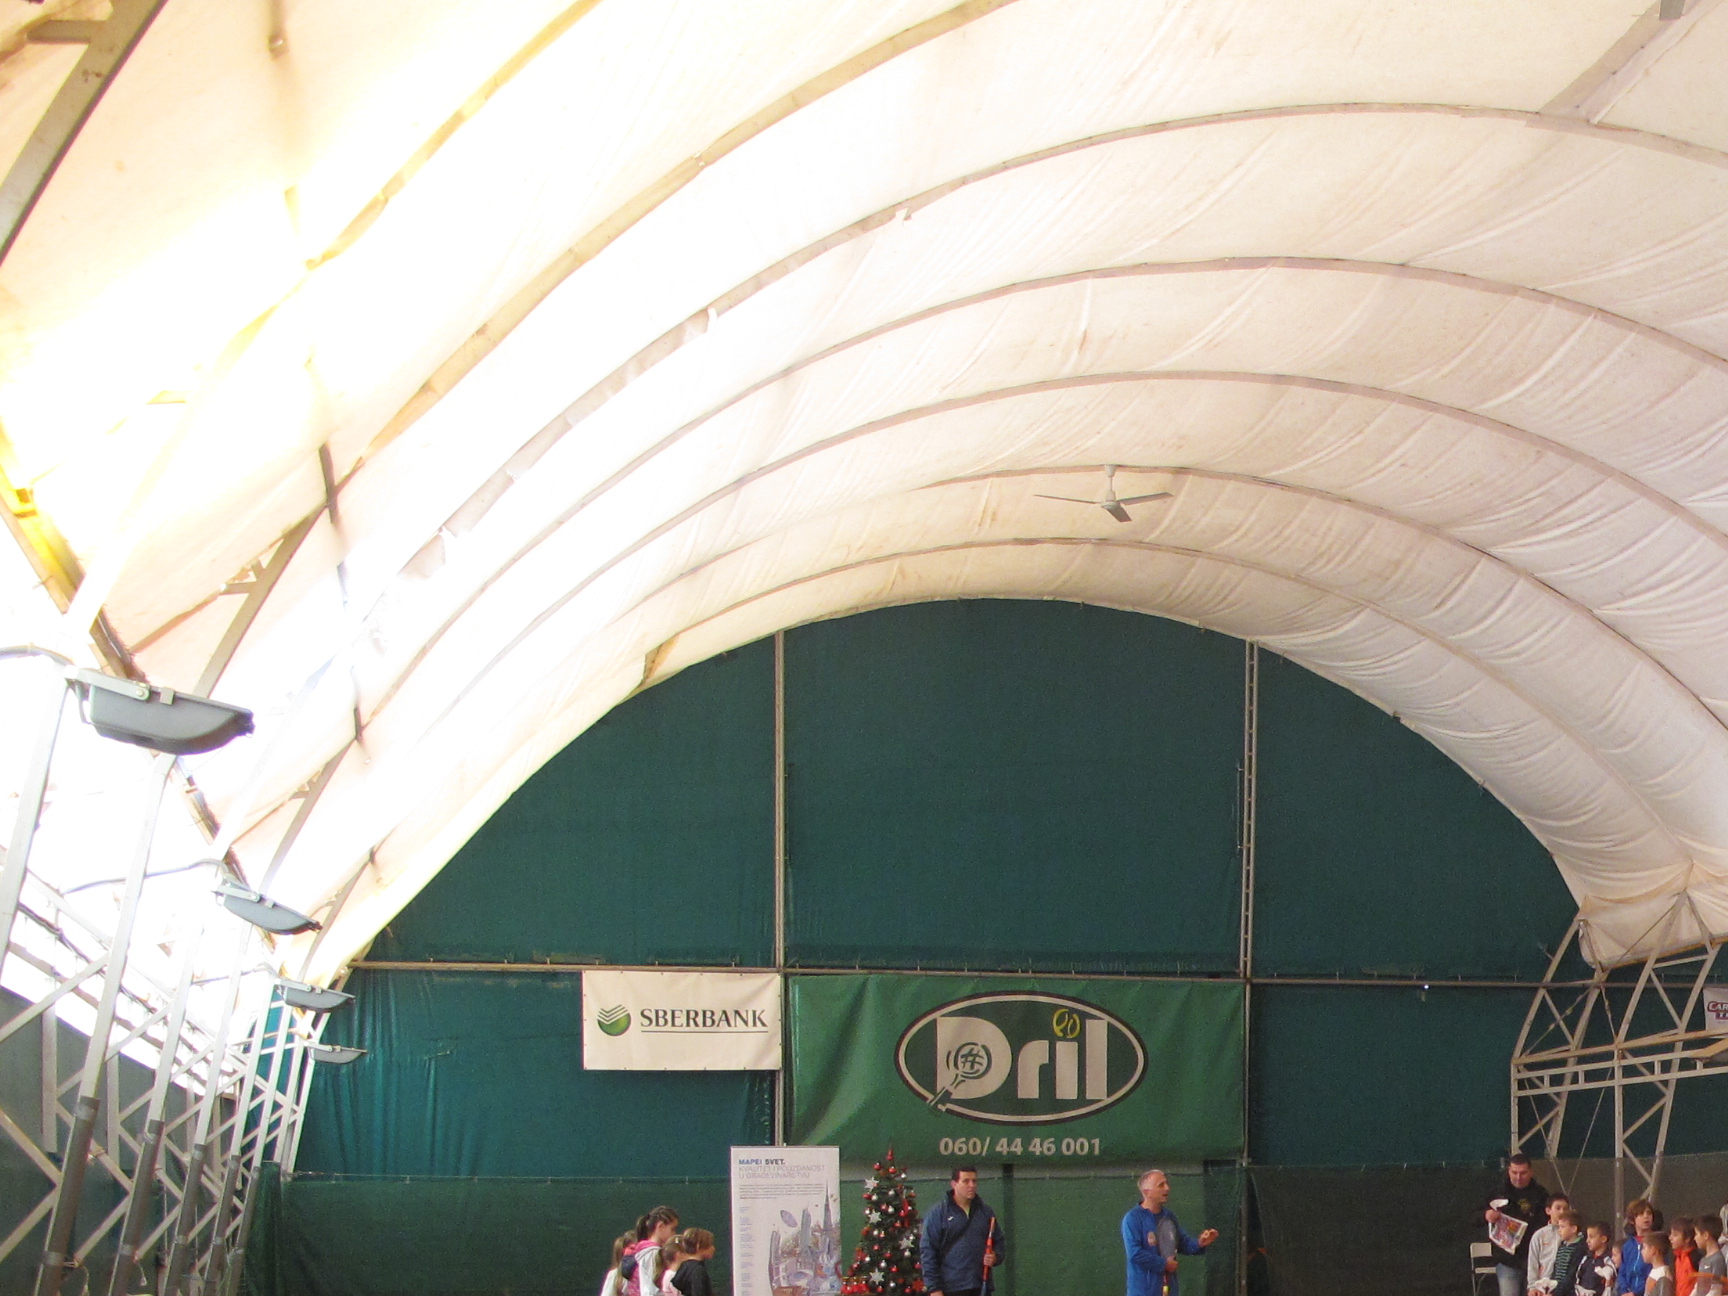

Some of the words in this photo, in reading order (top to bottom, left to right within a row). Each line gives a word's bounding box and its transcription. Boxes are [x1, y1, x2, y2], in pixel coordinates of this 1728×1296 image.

[640, 1008, 768, 1028] SBERBANK
[936, 1011, 1108, 1100] Dril
[939, 1136, 991, 1156] 060/
[995, 1137, 1024, 1156] 44
[1028, 1137, 1056, 1156] 46
[1061, 1137, 1100, 1156] 001
